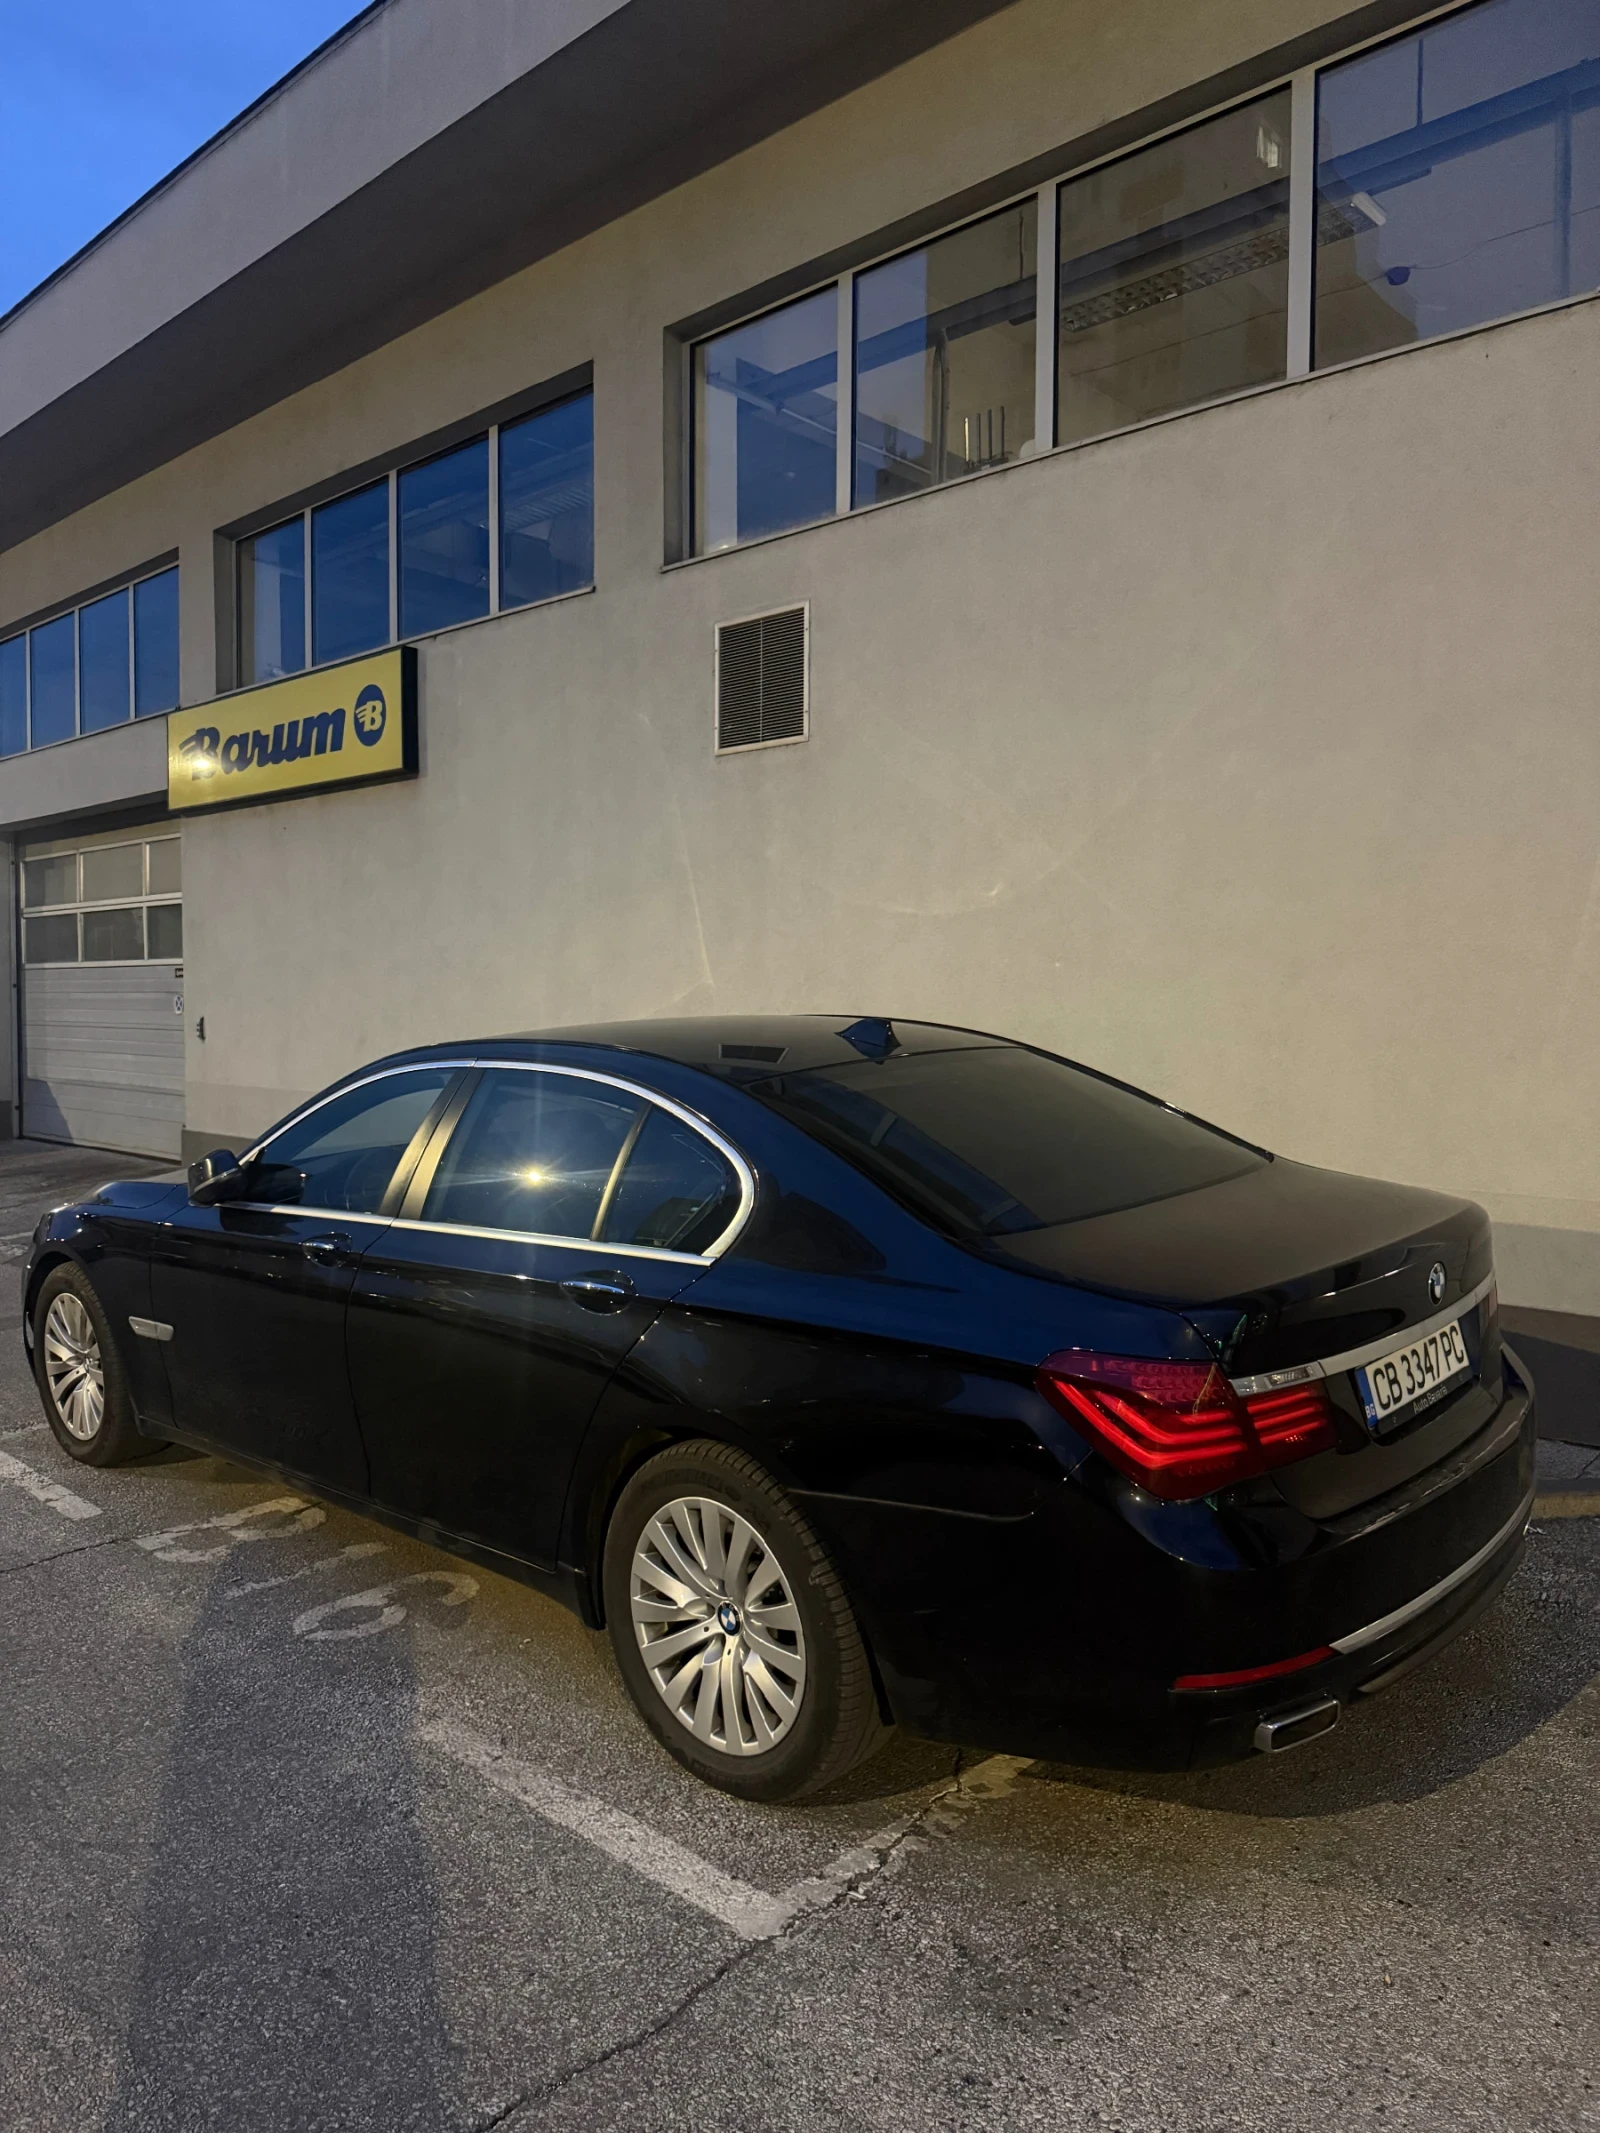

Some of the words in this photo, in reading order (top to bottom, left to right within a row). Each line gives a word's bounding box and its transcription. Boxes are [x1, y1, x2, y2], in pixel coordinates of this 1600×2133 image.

[179, 708, 346, 781] Barum
[1373, 1361, 1402, 1411] CB
[1401, 1337, 1441, 1396] 3347
[1439, 1325, 1465, 1372] PC
[1365, 1403, 1376, 1418] BG
